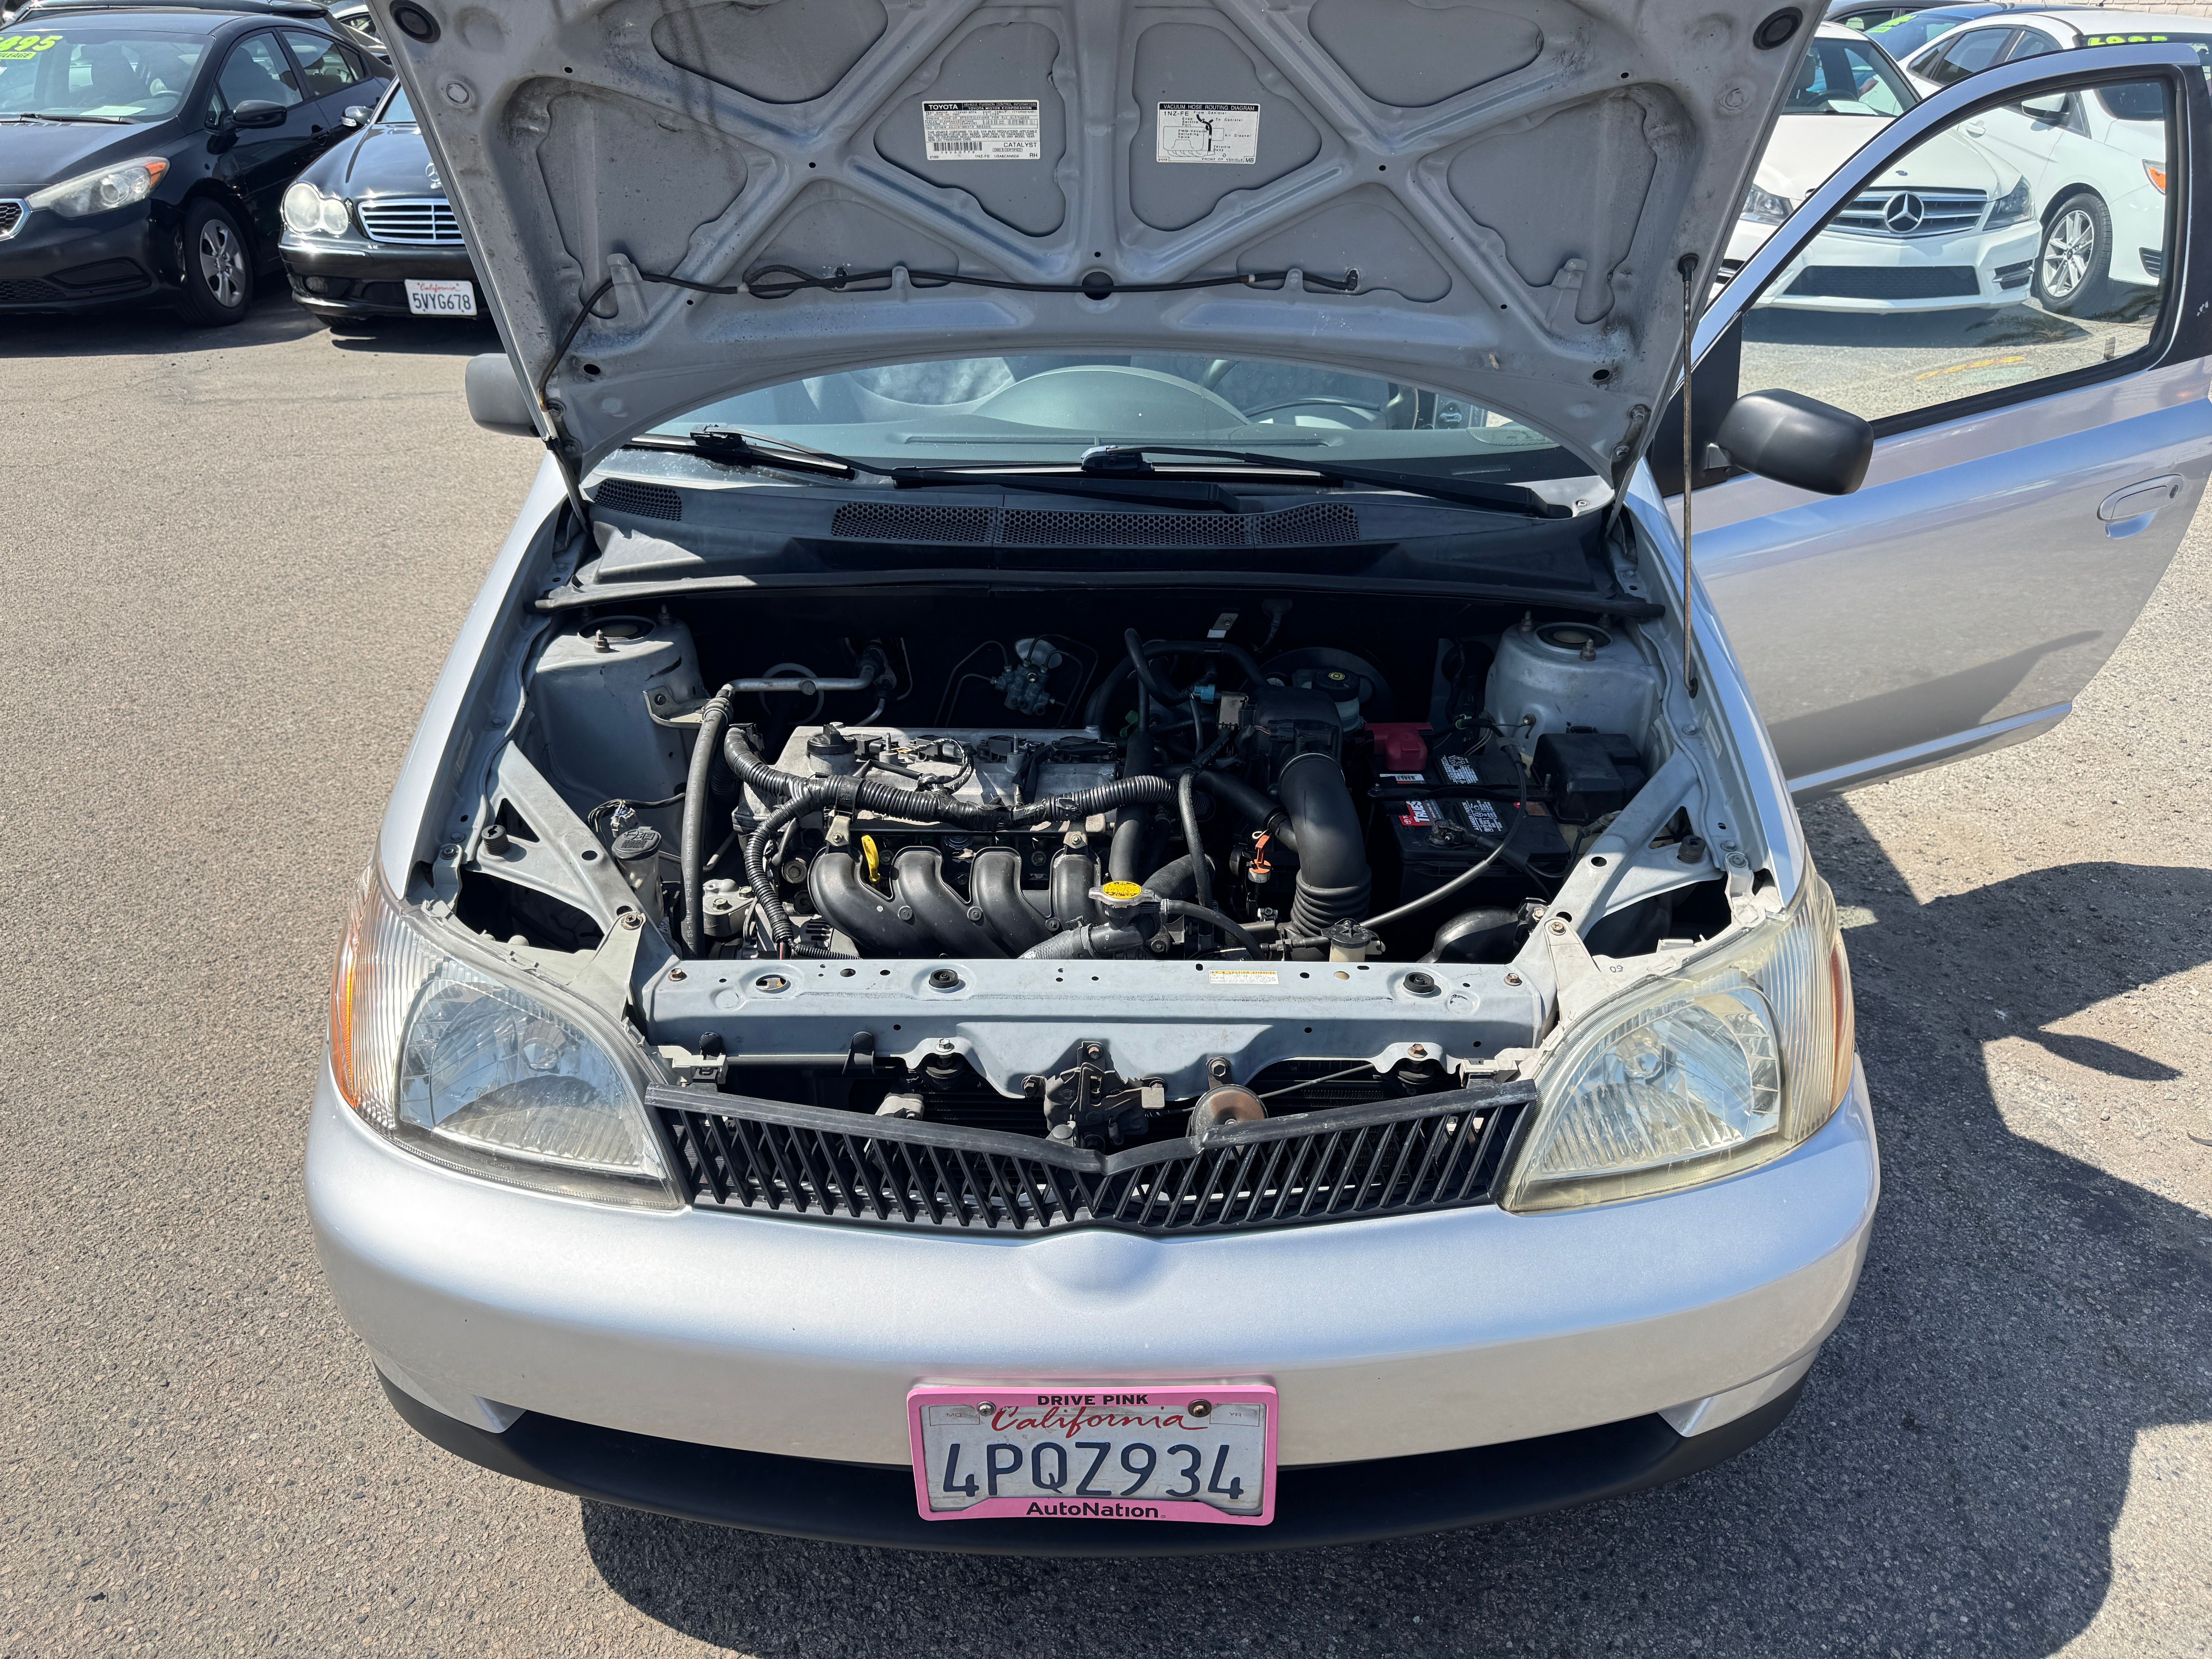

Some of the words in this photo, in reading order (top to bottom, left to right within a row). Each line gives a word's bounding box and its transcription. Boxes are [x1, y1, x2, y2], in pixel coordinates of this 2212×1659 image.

[0, 36, 63, 51] 895
[412, 293, 471, 310] 5VYG678
[1037, 1395, 1096, 1405] DRIVE
[1103, 1394, 1149, 1405] PINK
[991, 1406, 1208, 1439] California
[943, 1441, 1244, 1500] 4PQZ934
[1025, 1501, 1159, 1518] AutoNation
